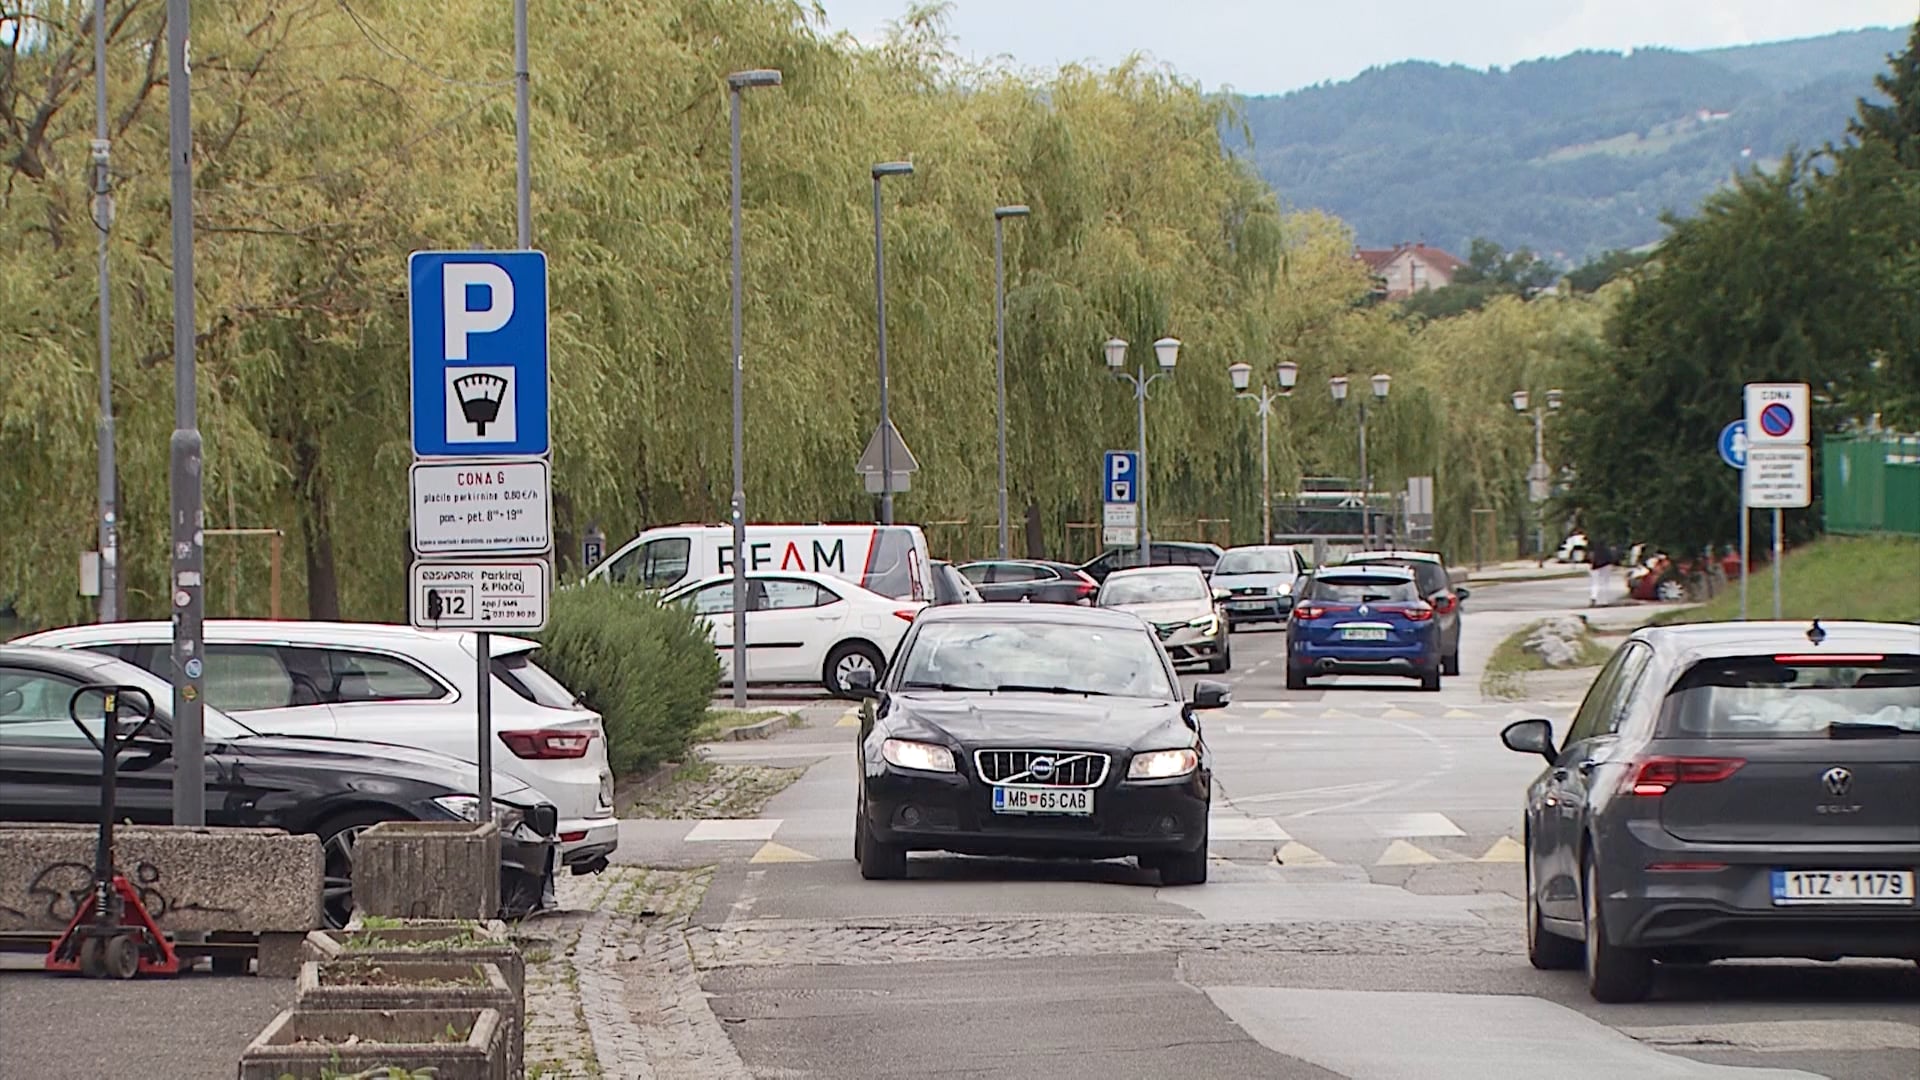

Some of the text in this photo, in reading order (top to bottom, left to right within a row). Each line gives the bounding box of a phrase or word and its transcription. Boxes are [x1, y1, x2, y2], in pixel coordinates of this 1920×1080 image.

[443, 262, 515, 361] P
[1111, 455, 1130, 480] P
[457, 471, 493, 486] CONA
[467, 511, 485, 524] pet.
[481, 570, 522, 582] Parkiraj
[481, 583, 490, 592] &
[1008, 790, 1028, 807] MB
[1792, 874, 1903, 895] 1TZ 1179
